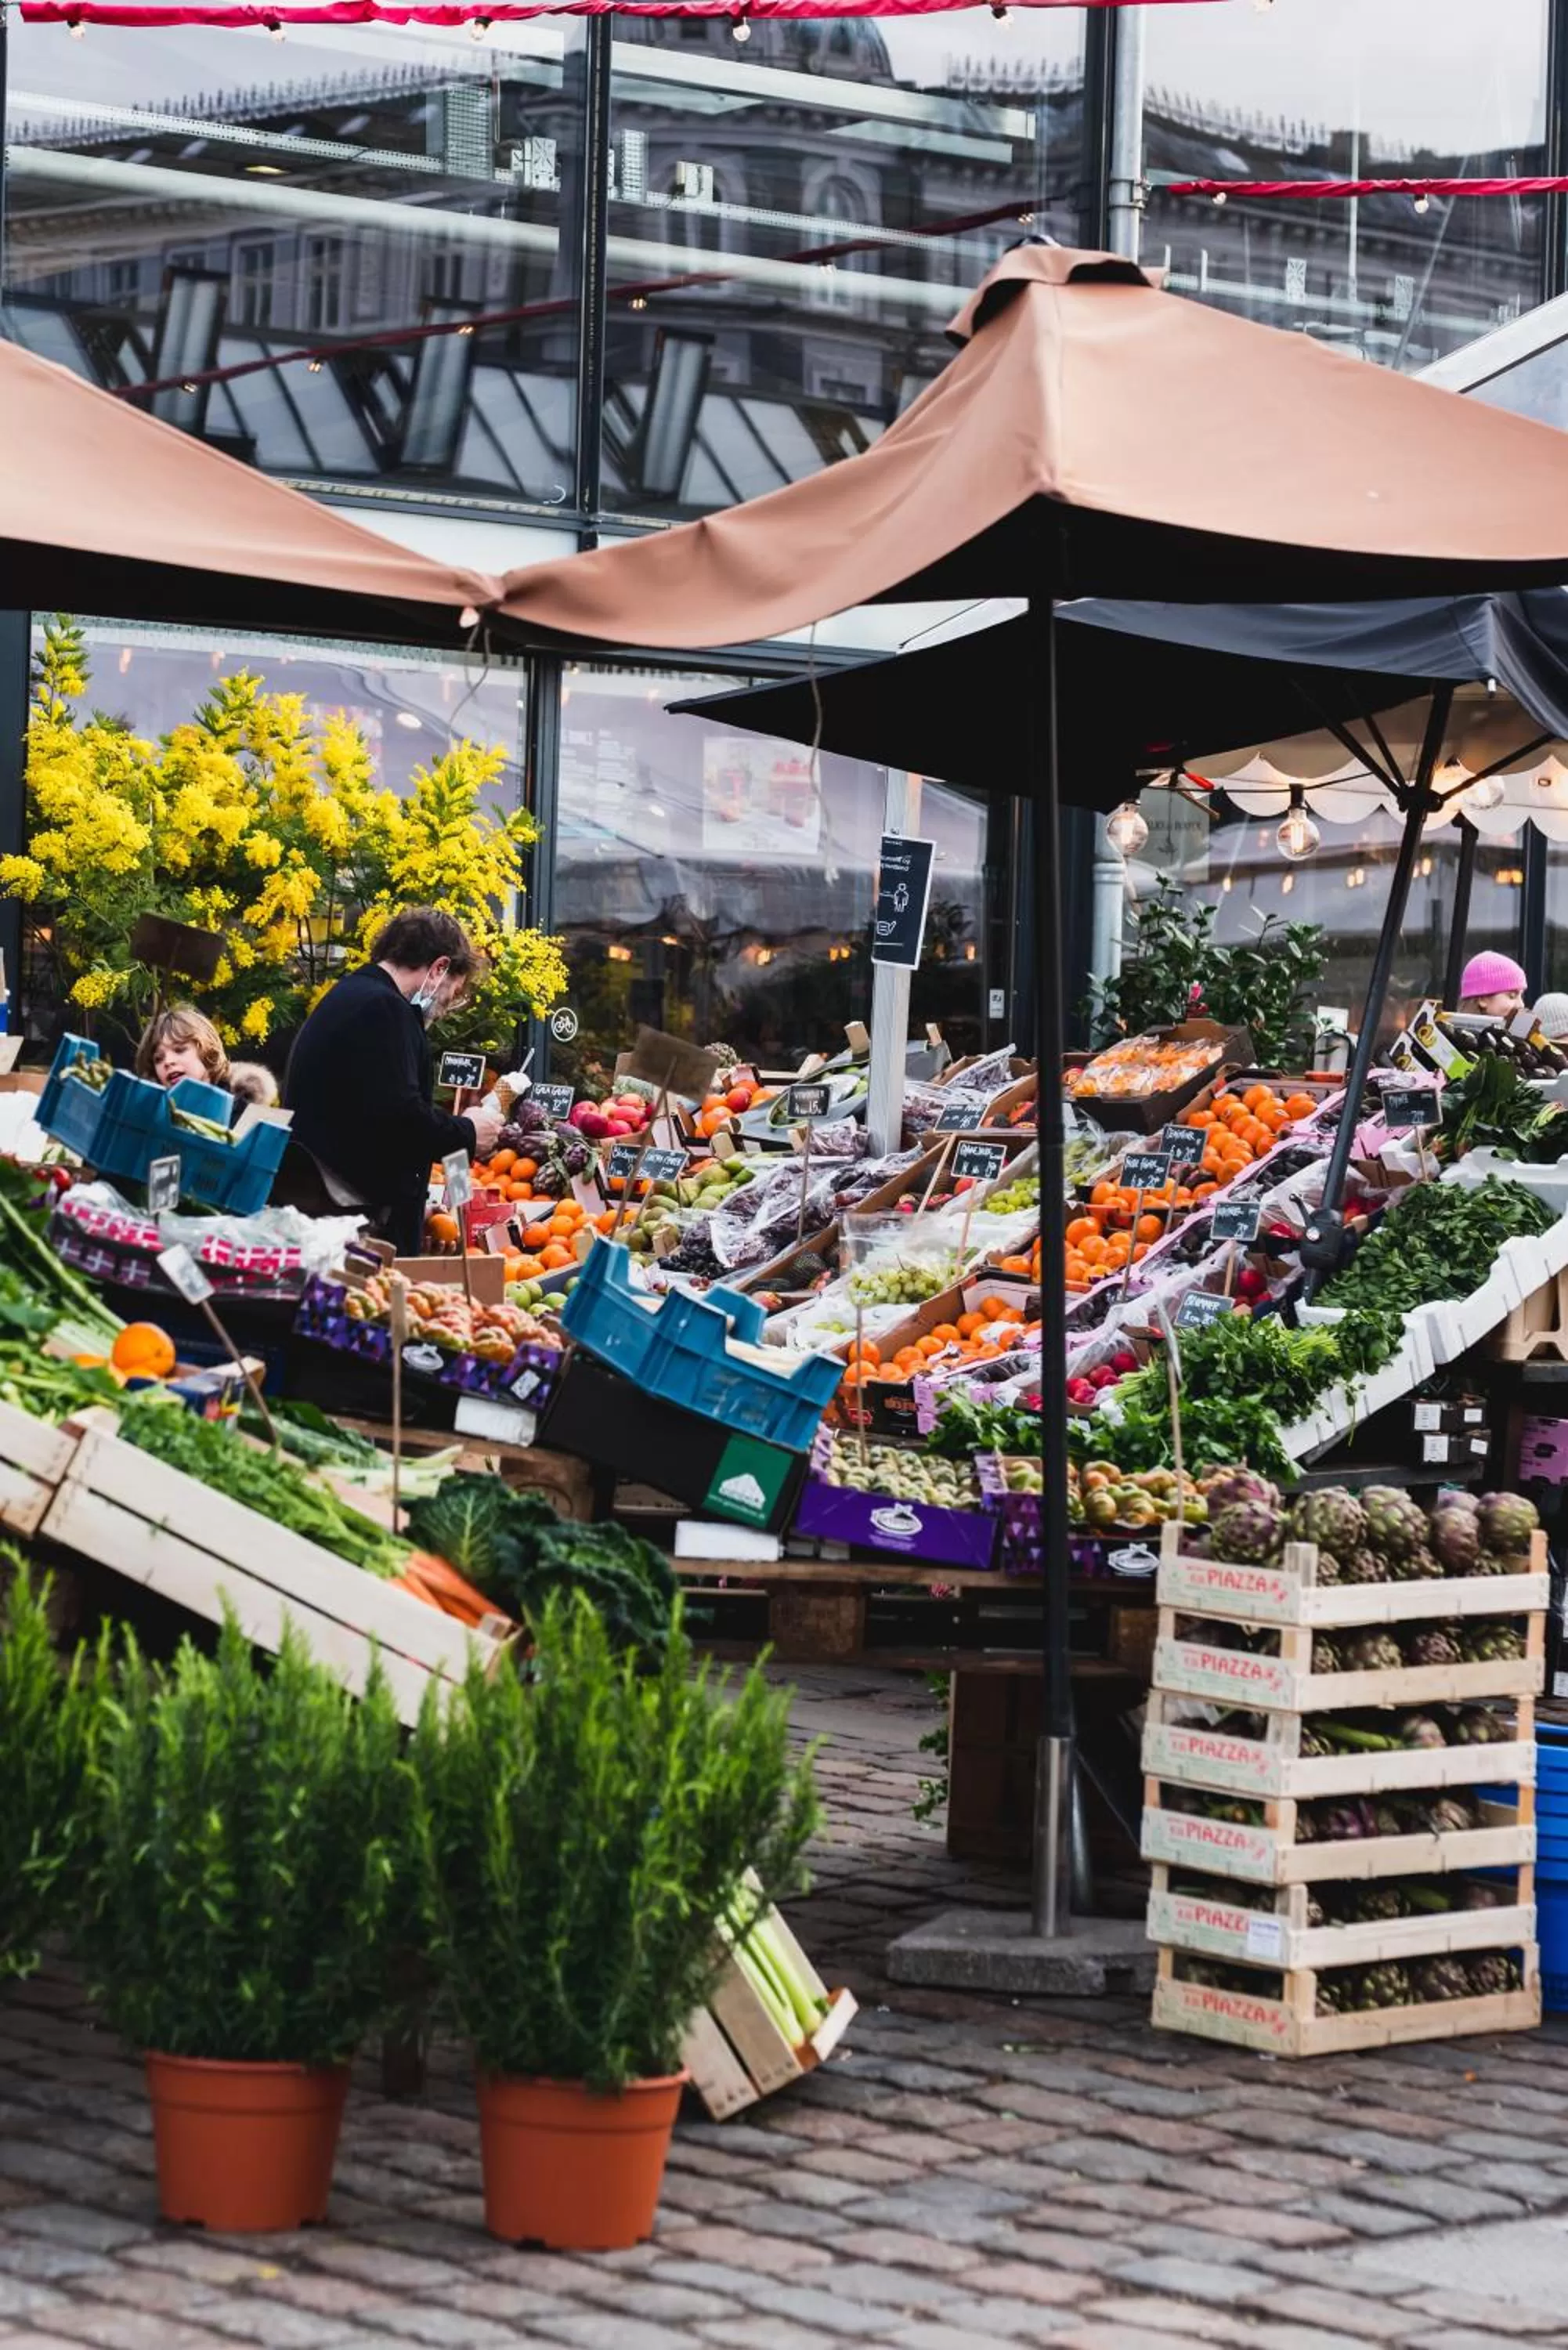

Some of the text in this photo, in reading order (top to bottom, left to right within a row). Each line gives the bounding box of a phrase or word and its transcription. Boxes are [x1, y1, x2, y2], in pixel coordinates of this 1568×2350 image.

[1207, 1568, 1266, 1593] PIAZZA
[1201, 1653, 1263, 1679] PIAZZA
[1189, 1736, 1249, 1762] PIAZZA
[1185, 1820, 1247, 1848] PIAZZA
[1194, 1904, 1250, 1932] PIAZZ
[1202, 1992, 1266, 2023] PIAZZA
